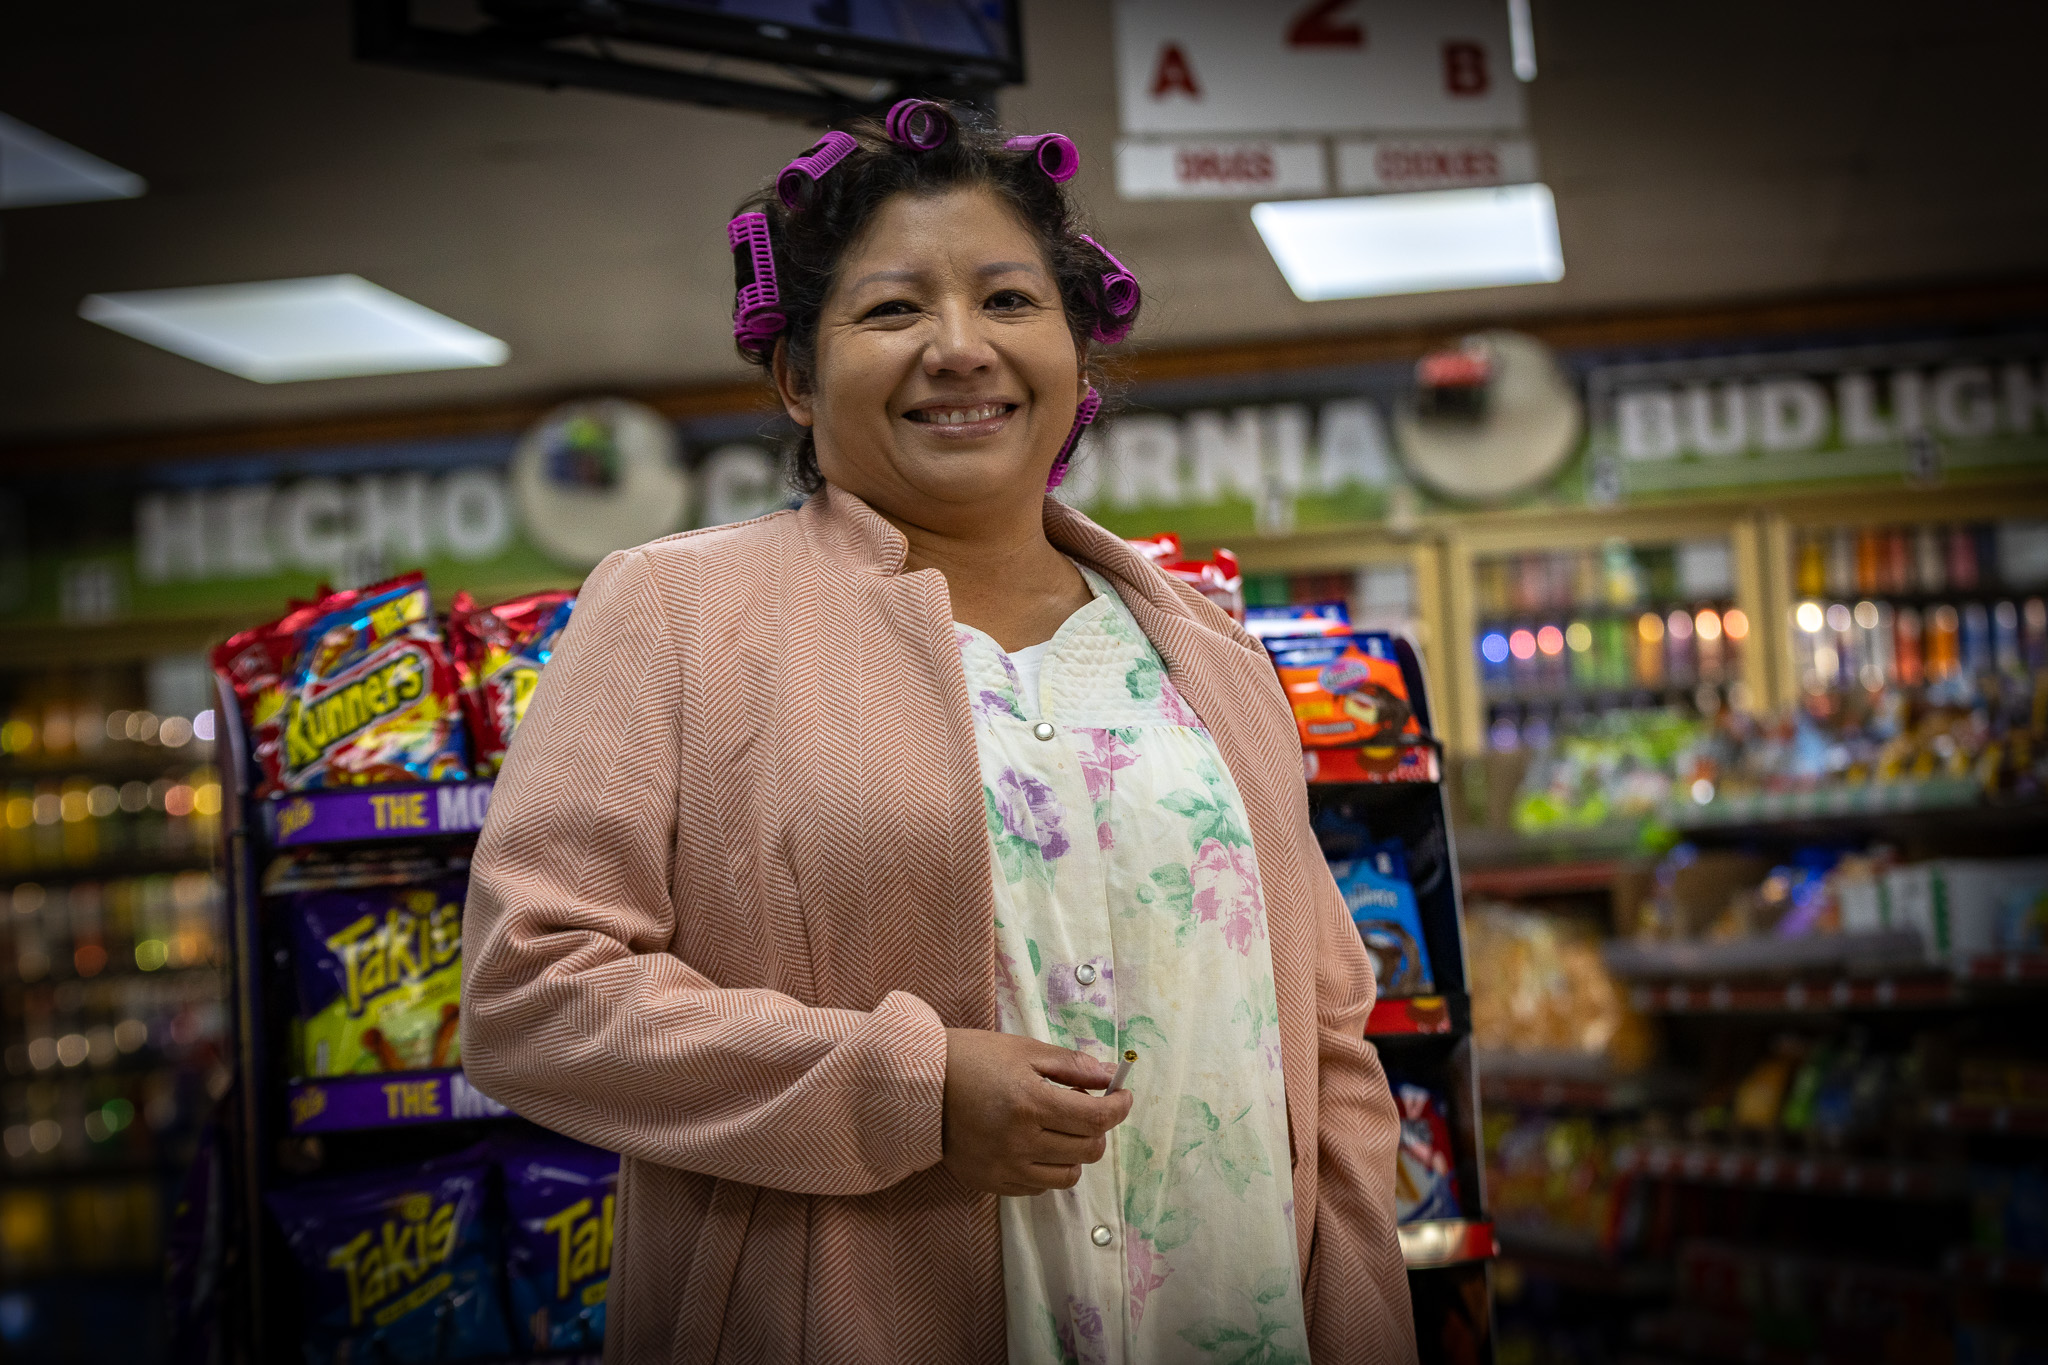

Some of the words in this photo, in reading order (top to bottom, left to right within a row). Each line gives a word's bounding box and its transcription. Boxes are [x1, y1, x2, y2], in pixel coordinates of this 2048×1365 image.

[1151, 42, 1200, 97] A
[1444, 40, 1490, 97] B
[1618, 378, 1830, 460] BUD
[136, 470, 510, 582] HECHO
[369, 792, 430, 831] THE
[326, 889, 463, 1015] Takis
[381, 1080, 442, 1119] THE
[326, 1194, 455, 1328] Takis
